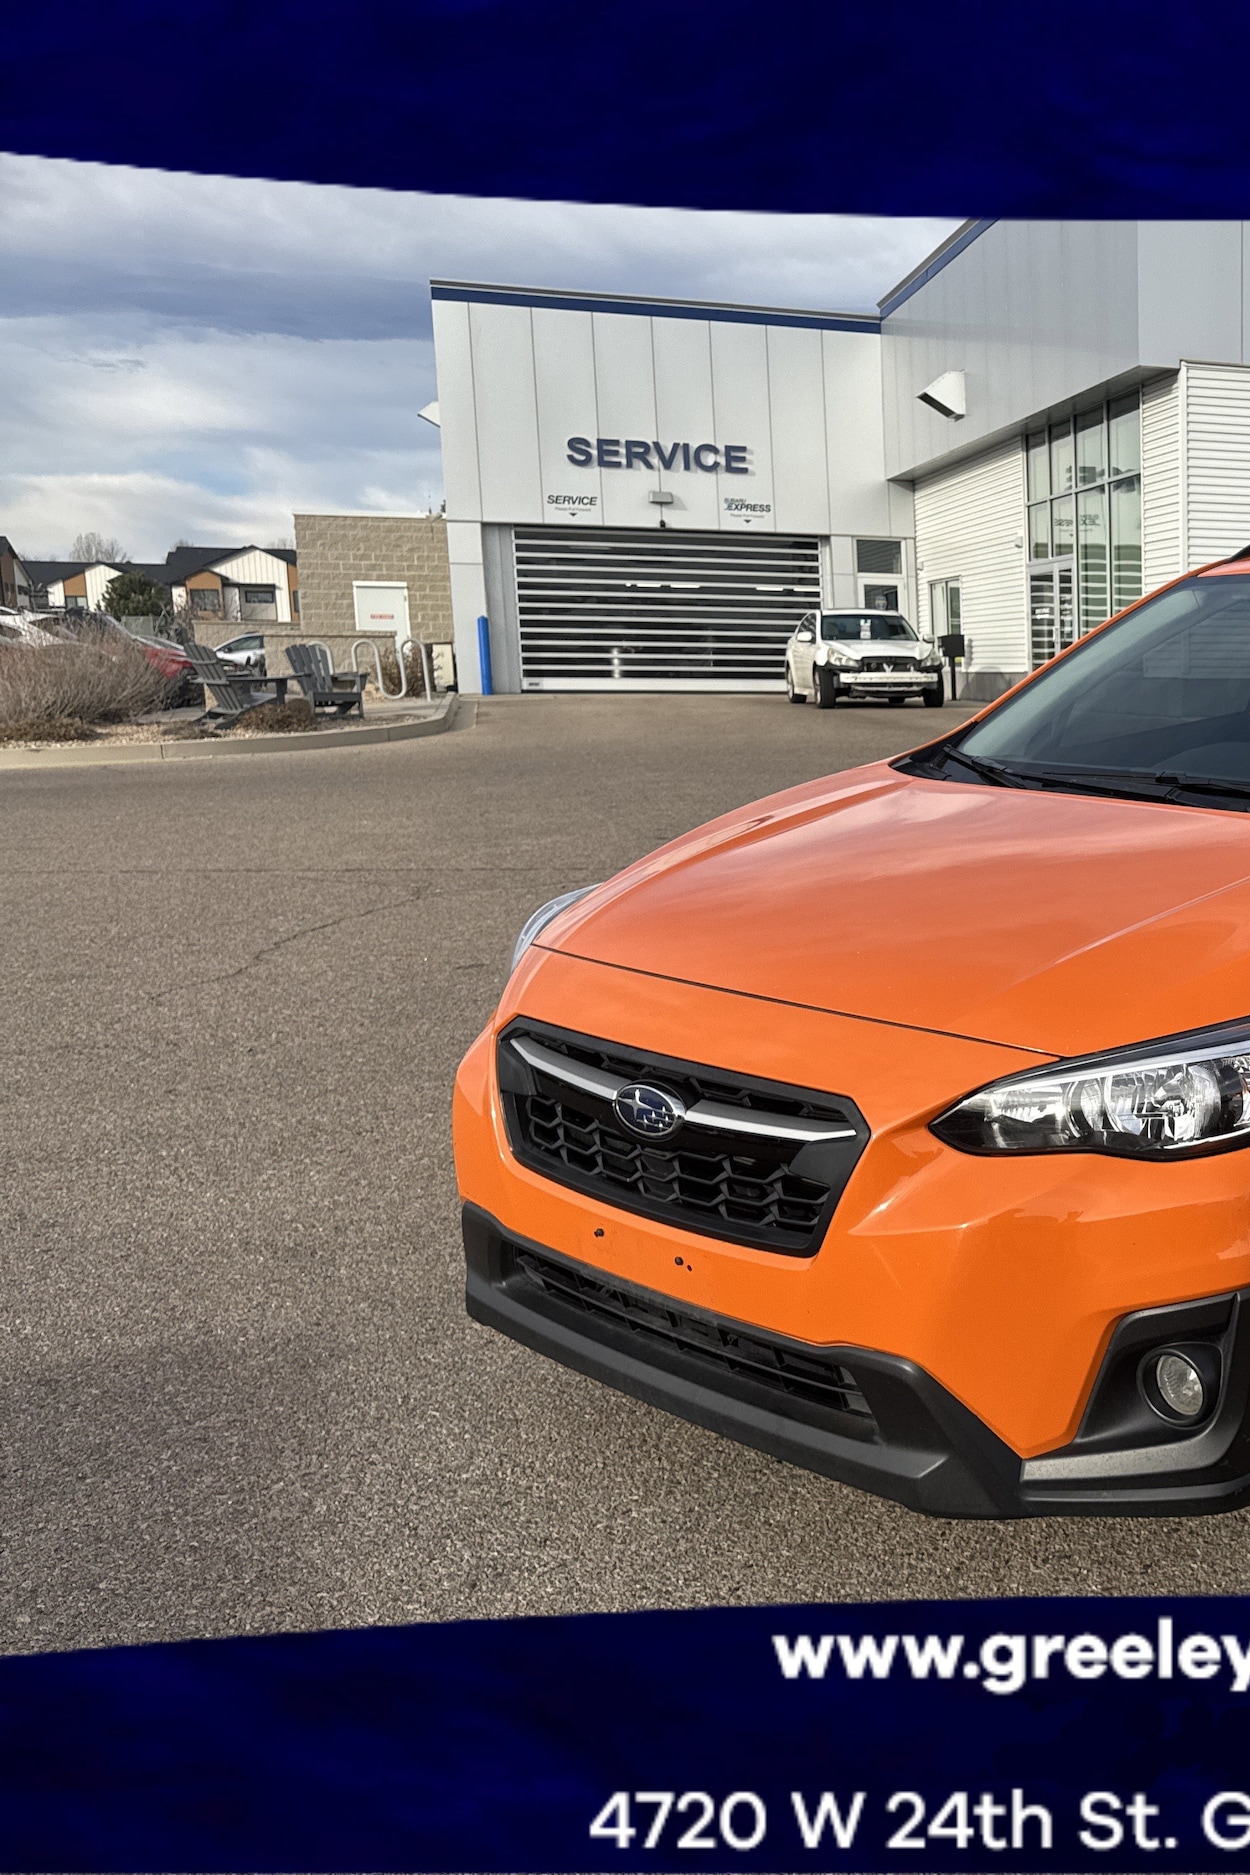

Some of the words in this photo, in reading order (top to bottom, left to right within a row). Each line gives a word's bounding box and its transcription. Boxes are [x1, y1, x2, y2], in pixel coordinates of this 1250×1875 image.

[566, 437, 750, 474] SERVICE
[546, 494, 598, 506] SERVICE
[726, 503, 771, 513] EXPRESS
